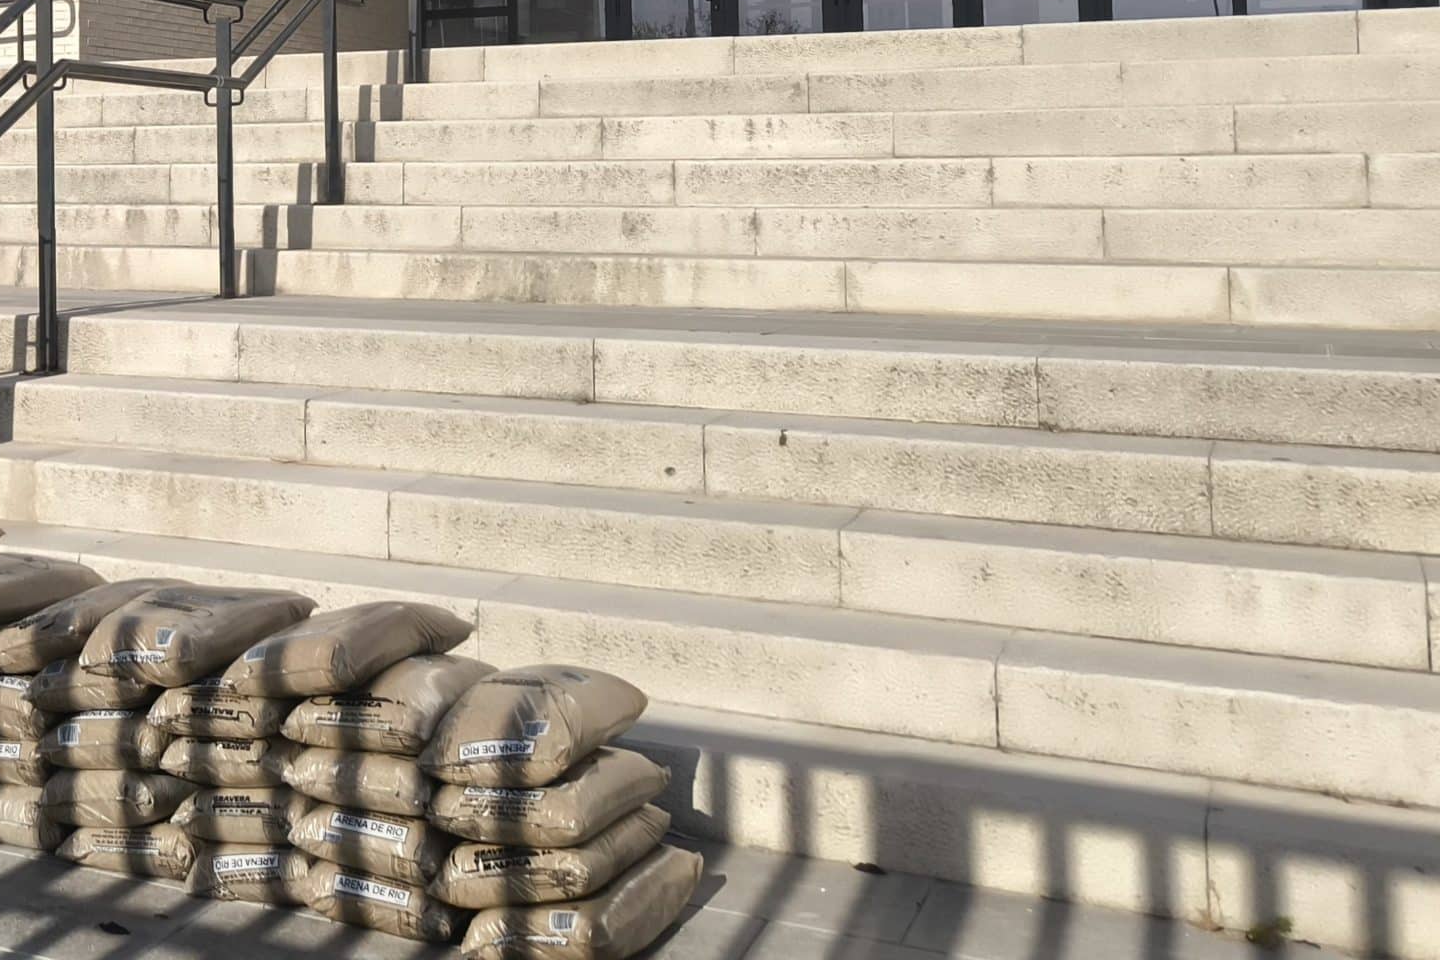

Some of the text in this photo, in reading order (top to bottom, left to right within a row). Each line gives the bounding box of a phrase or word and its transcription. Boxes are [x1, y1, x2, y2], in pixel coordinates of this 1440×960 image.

[5, 744, 18, 754] RIO
[462, 744, 480, 757] RIO
[482, 744, 496, 754] DE
[334, 814, 368, 828] ARENA
[370, 823, 383, 833] DE
[386, 825, 404, 837] RIO
[215, 856, 277, 870] ARENA DE RIO
[338, 877, 370, 892] ARENA
[372, 885, 386, 896] DE
[388, 889, 406, 900] RIO
